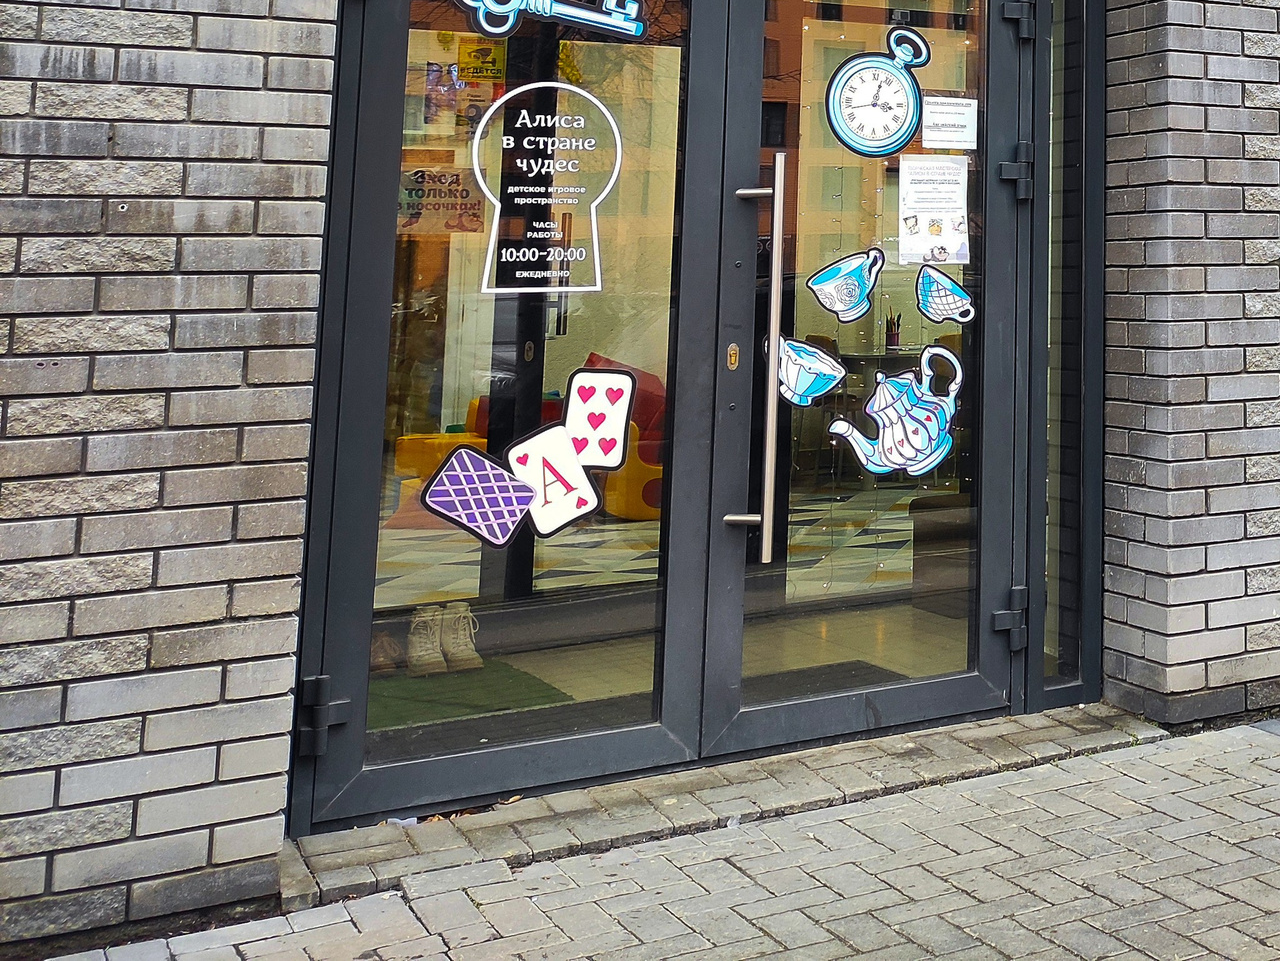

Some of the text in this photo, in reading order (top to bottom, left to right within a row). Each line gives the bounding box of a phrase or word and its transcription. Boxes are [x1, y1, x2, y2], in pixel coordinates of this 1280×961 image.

[514, 109, 585, 129] Алиса
[502, 135, 597, 154] в стране
[516, 157, 580, 177] чудес
[507, 186, 587, 195] детское игровое
[514, 197, 579, 206] пространство
[532, 221, 558, 229] ЧАСЫ
[527, 231, 564, 239] РАБОТЫ
[515, 270, 570, 278] ЕЖЕДНЕВНО
